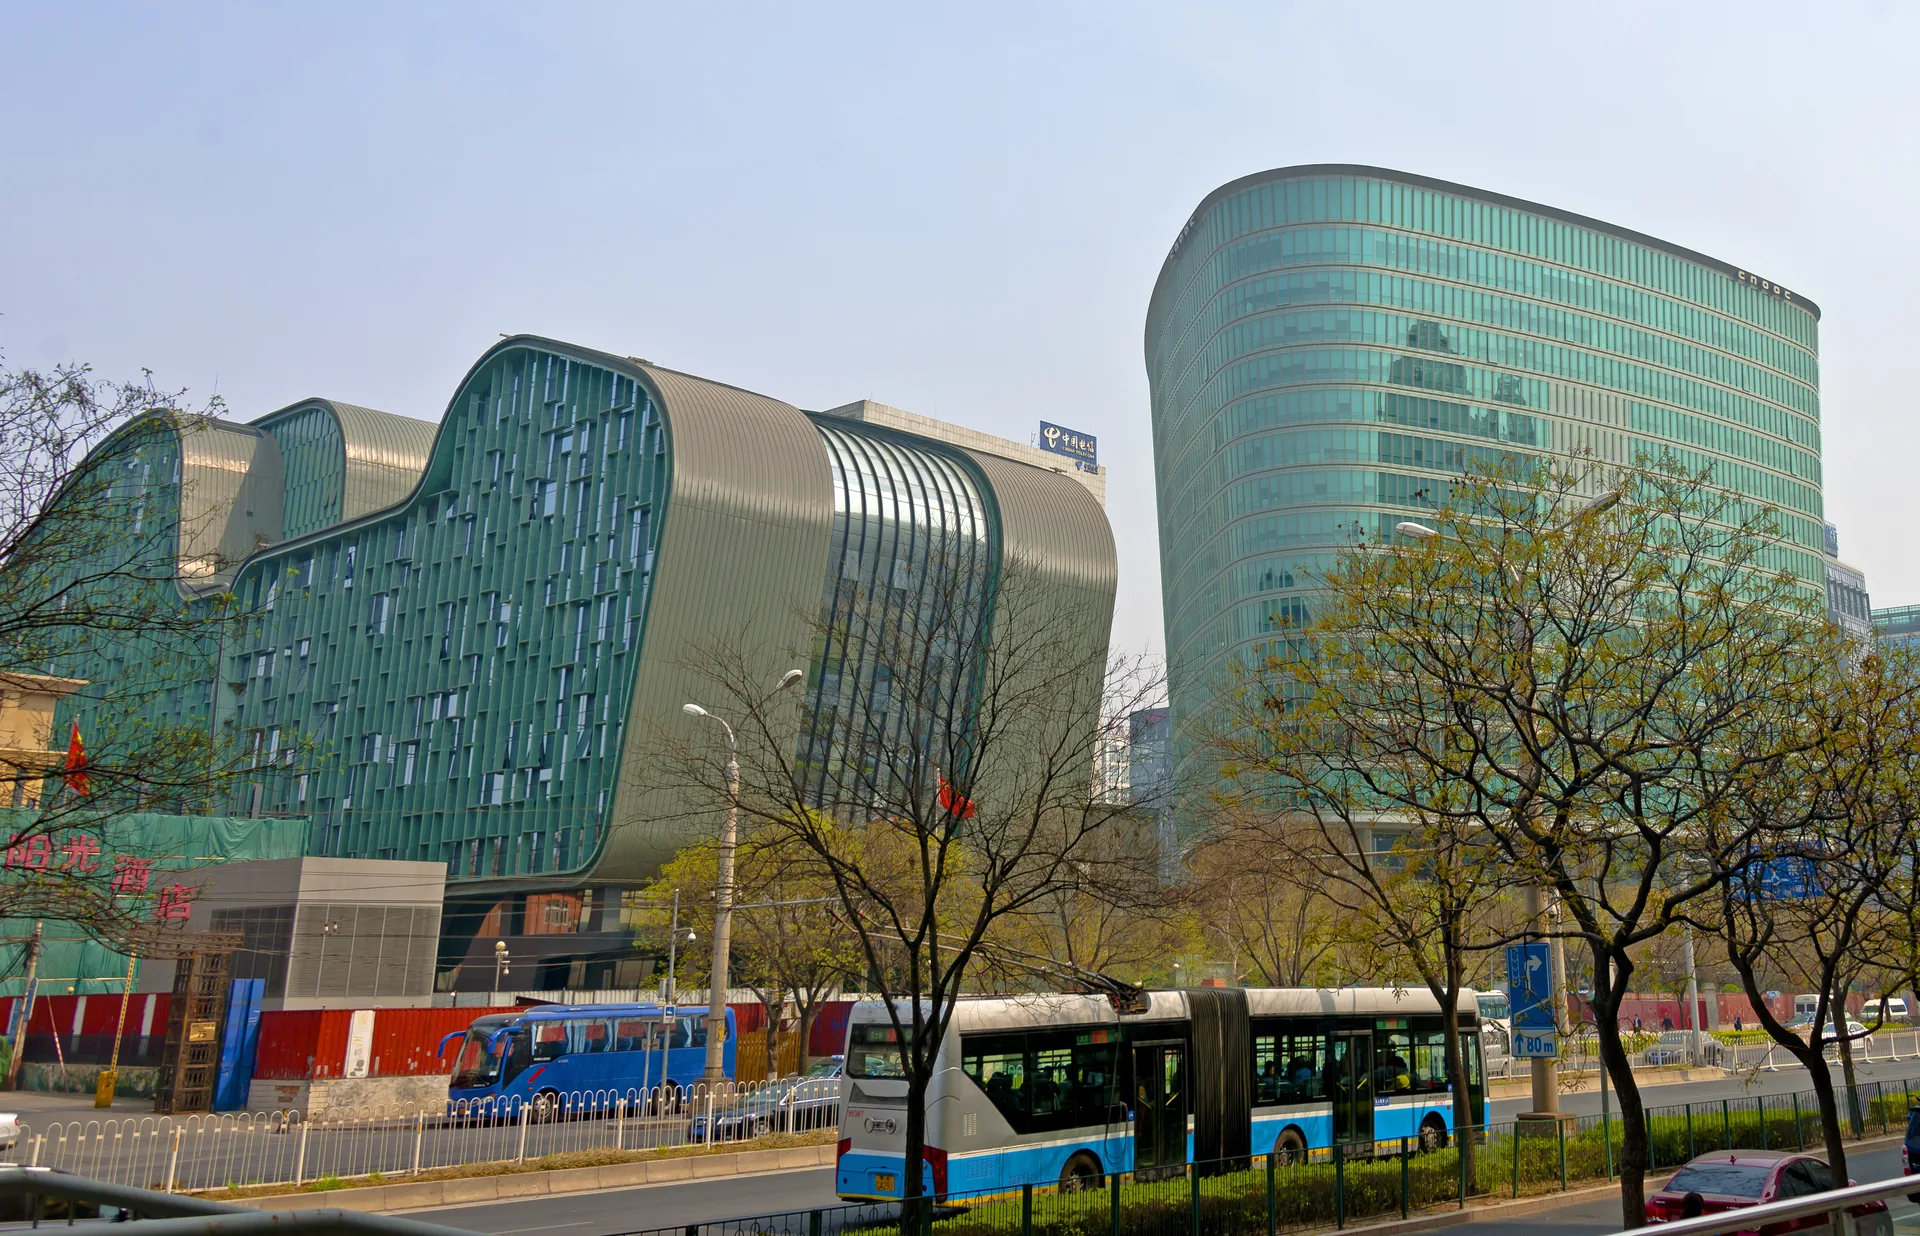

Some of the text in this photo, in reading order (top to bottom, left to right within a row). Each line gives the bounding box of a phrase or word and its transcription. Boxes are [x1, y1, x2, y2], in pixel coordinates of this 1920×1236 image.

[1062, 432, 1095, 453] 中国电信
[4, 833, 196, 919] 阳光酒店
[1526, 1036, 1553, 1053] 80 m
